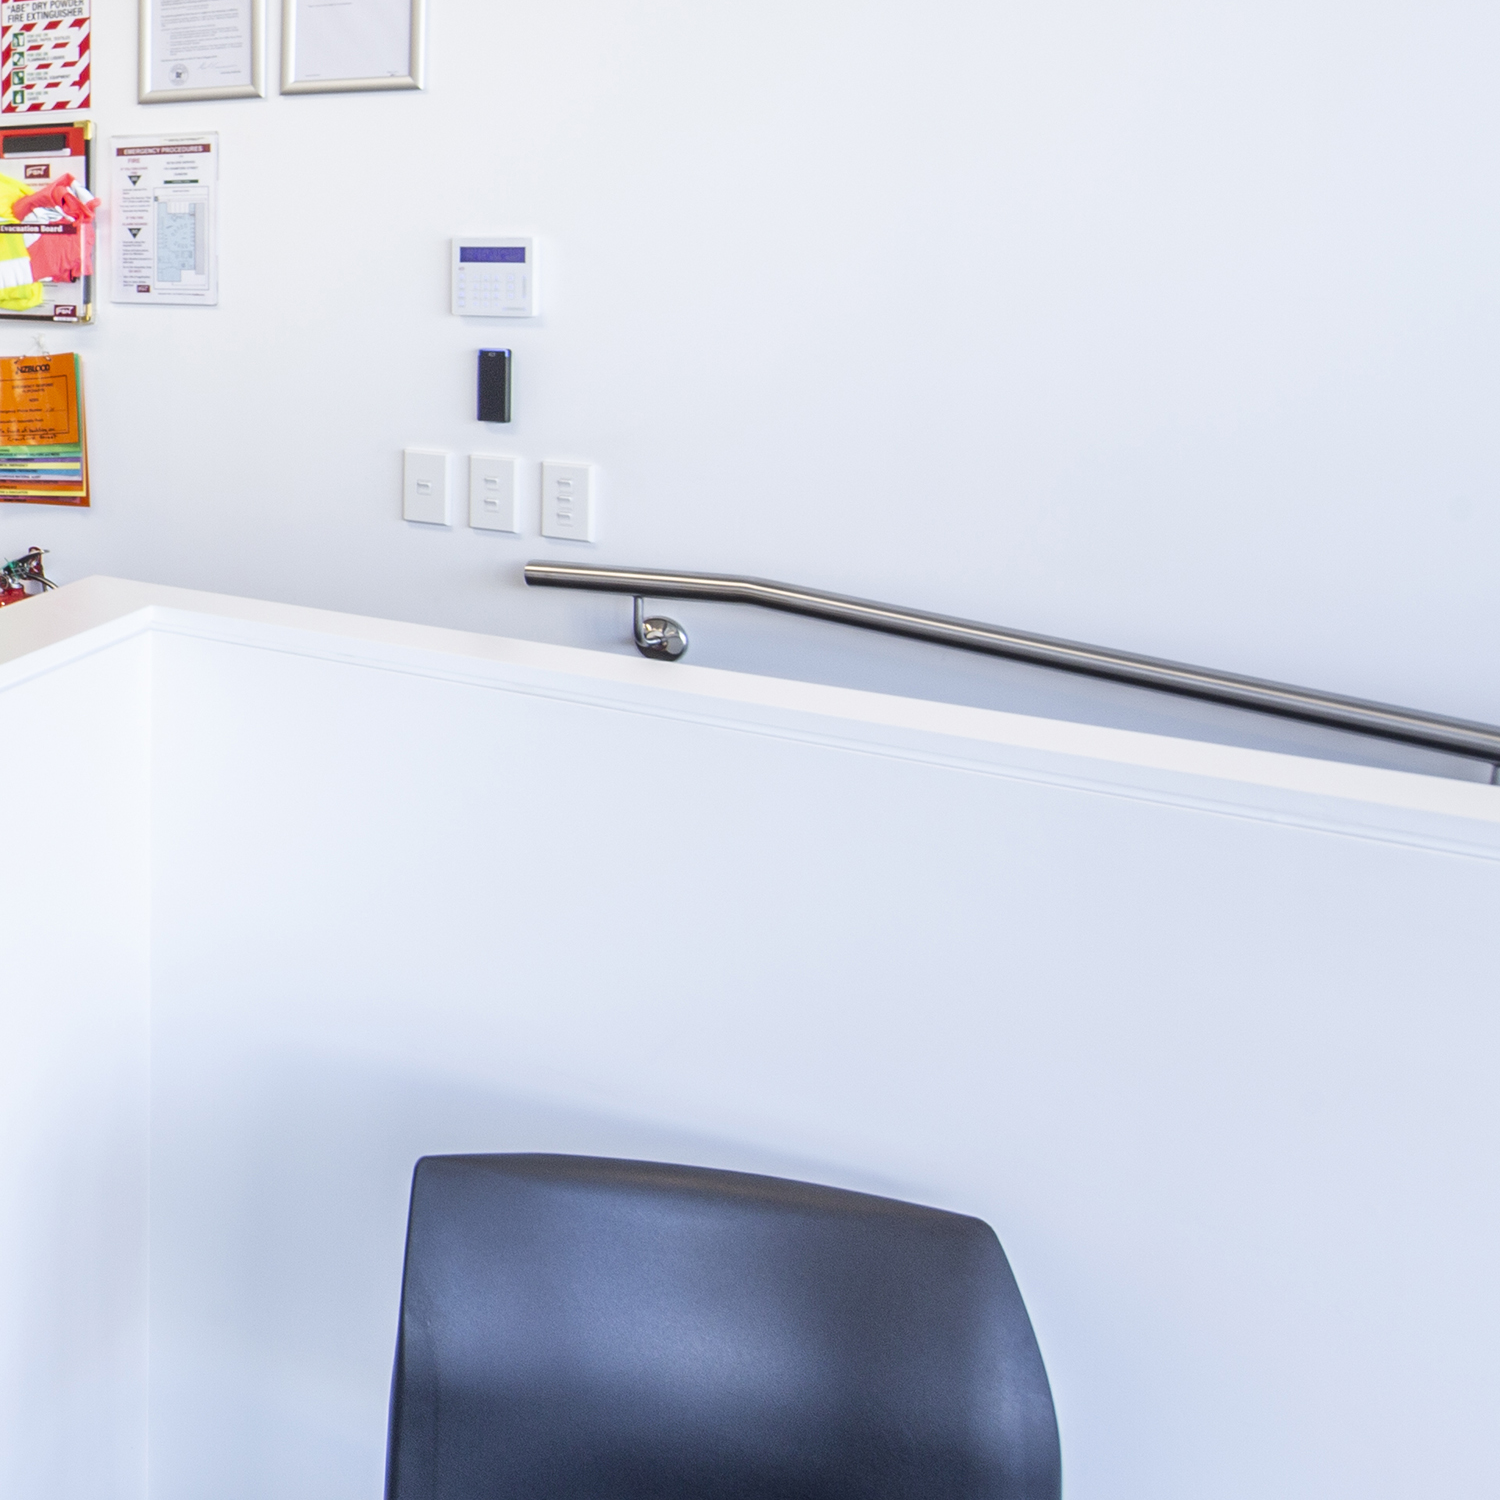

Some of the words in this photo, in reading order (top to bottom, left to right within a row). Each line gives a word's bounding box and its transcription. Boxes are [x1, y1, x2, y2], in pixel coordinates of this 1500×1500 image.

[32, 2, 47, 11] DRY
[7, 13, 24, 23] FIRE
[26, 7, 83, 21] EXTINGUISHER
[123, 147, 160, 155] EMERGENCY
[161, 145, 204, 153] PROCEDURES
[40, 225, 63, 233] Board
